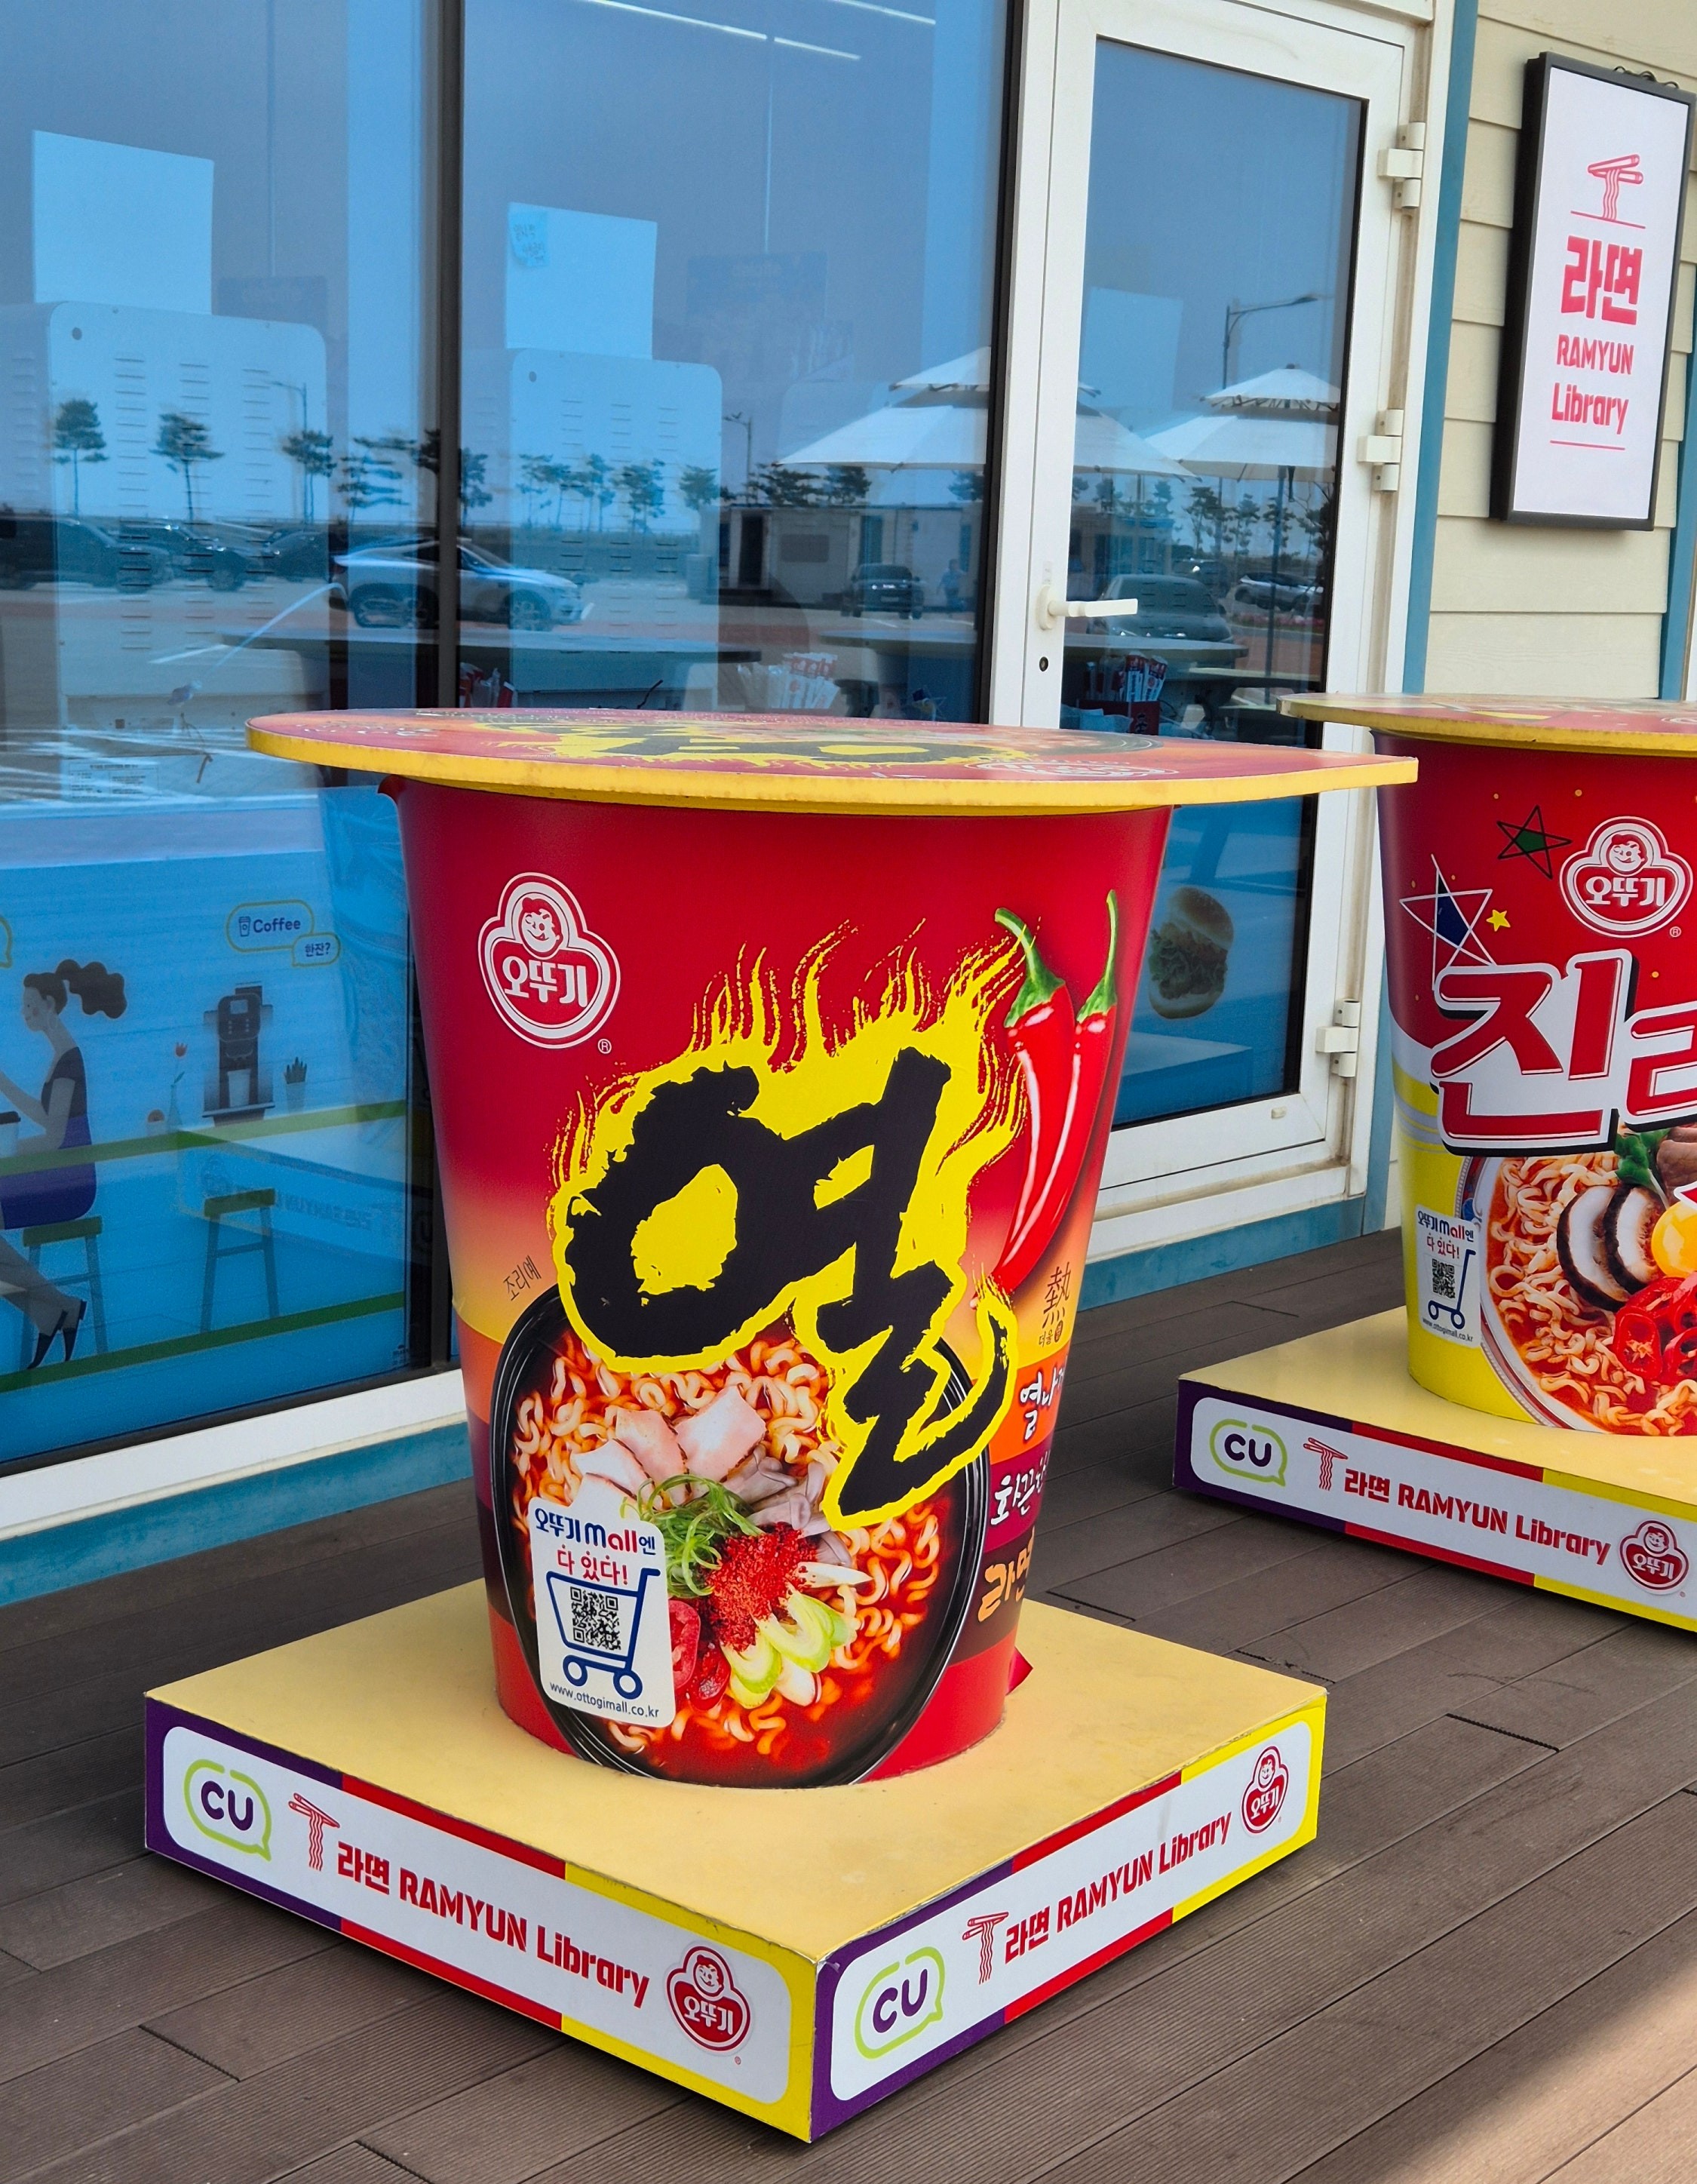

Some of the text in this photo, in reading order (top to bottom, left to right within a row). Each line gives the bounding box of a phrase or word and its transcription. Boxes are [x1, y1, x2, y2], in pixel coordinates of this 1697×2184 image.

[1561, 235, 1643, 325] 라면
[1556, 333, 1634, 375] RAMYUN
[1551, 382, 1629, 435] Library
[1585, 876, 1665, 907] 오뚜기
[253, 917, 301, 933] Coffee
[305, 942, 330, 957] 한잔?
[502, 956, 588, 1008] 오뚜기
[503, 1255, 542, 1301] 조리예
[565, 1046, 1012, 1516] 열
[1042, 1261, 1071, 1329] 熱
[1224, 1433, 1272, 1467] CU
[1345, 1468, 1612, 1566] 라면 RAMYUN Library
[557, 1544, 629, 1586] 다 있다!
[1632, 1553, 1674, 1581] 오뚜기
[550, 1682, 660, 1719] www.ottogimall.co.kr
[201, 1780, 253, 1831] CU
[1250, 1786, 1281, 1821] 오뚜기
[1005, 1811, 1232, 1965] 라면 RAMYUN Library
[338, 1841, 650, 2009] 라면 RAMYUN Library
[683, 1995, 734, 2035] 오뚜기
[873, 1969, 928, 2034] CU
